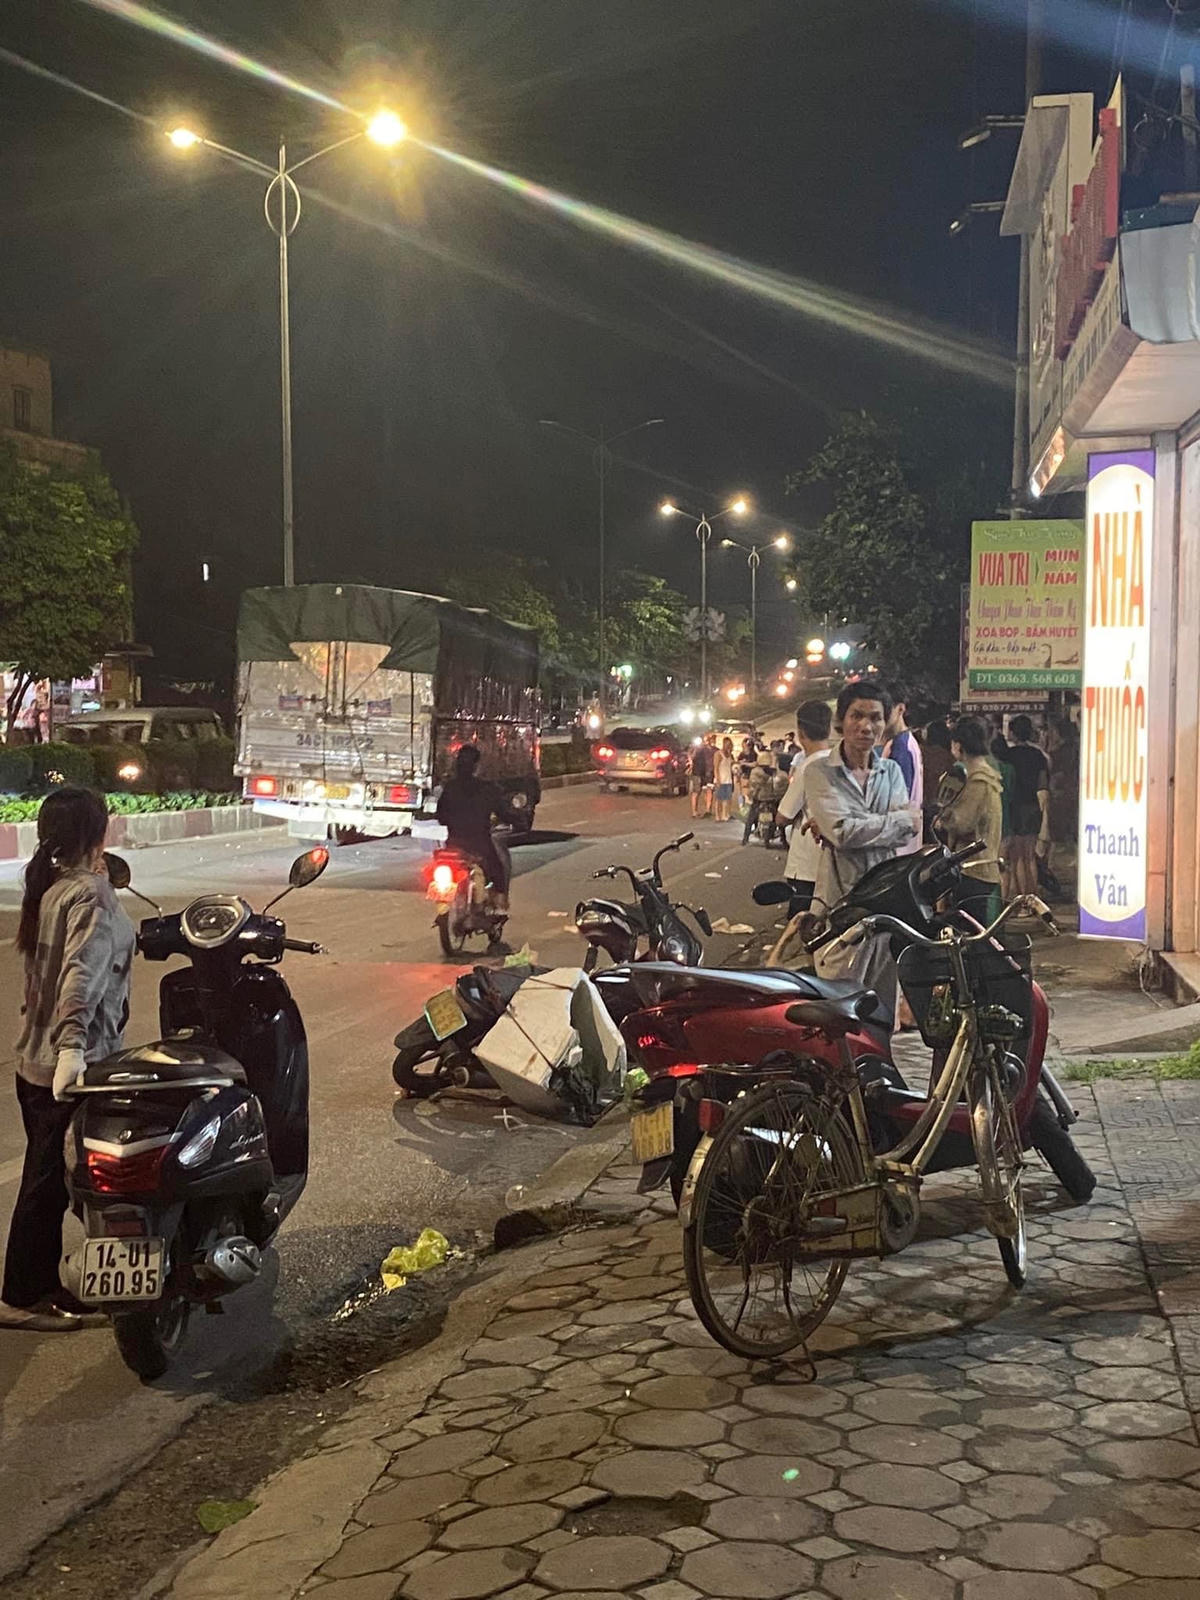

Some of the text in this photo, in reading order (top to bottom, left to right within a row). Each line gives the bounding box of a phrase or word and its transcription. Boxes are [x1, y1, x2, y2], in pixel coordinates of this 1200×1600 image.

[979, 552, 1004, 586] VUA
[1091, 484, 1144, 627] NHÀ
[976, 656, 1025, 667] Makeup
[1085, 641, 1144, 804] THUỐC
[1085, 824, 1140, 857] Thanh
[1094, 873, 1129, 907] Vân
[96, 1242, 151, 1269] 14-U1
[85, 1269, 158, 1297] 260.95
